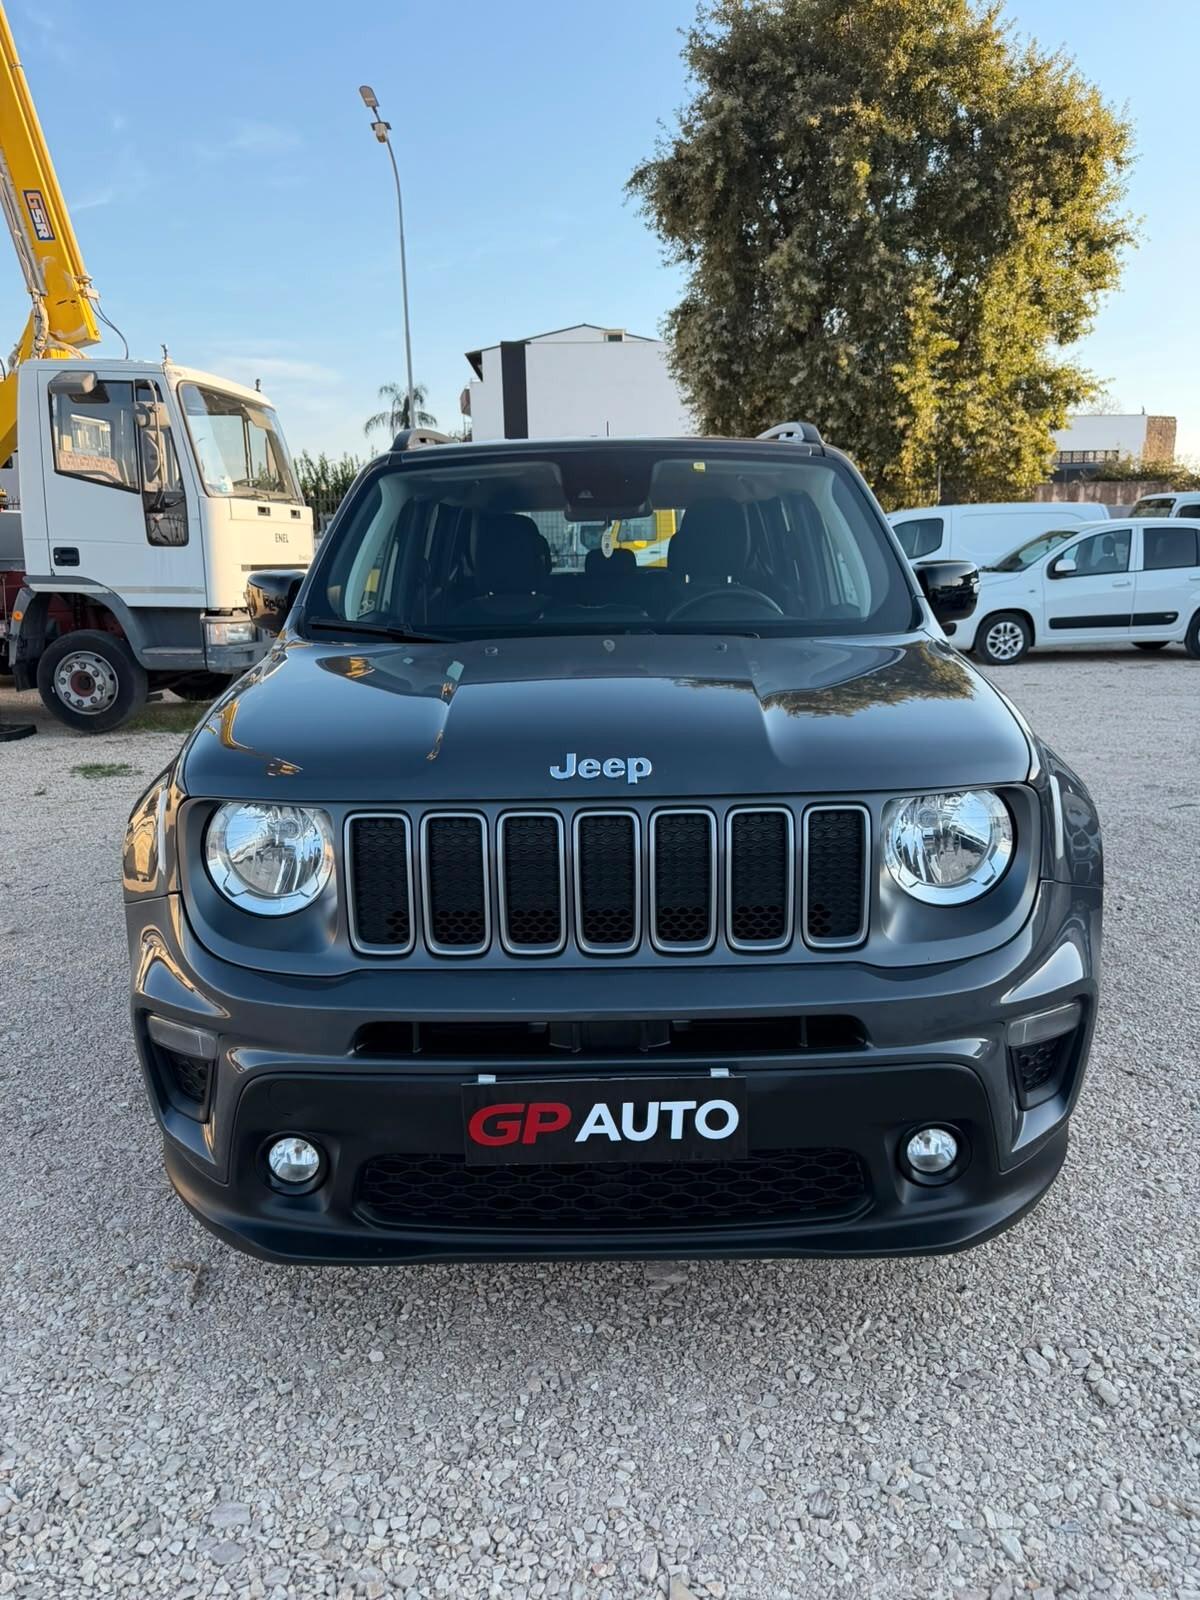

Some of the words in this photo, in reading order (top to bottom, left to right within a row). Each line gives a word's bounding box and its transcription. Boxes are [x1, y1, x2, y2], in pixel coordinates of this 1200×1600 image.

[274, 532, 289, 544] ENEL
[549, 752, 653, 785] Jeep
[468, 1102, 572, 1147] GP
[574, 1099, 740, 1143] AUTO
